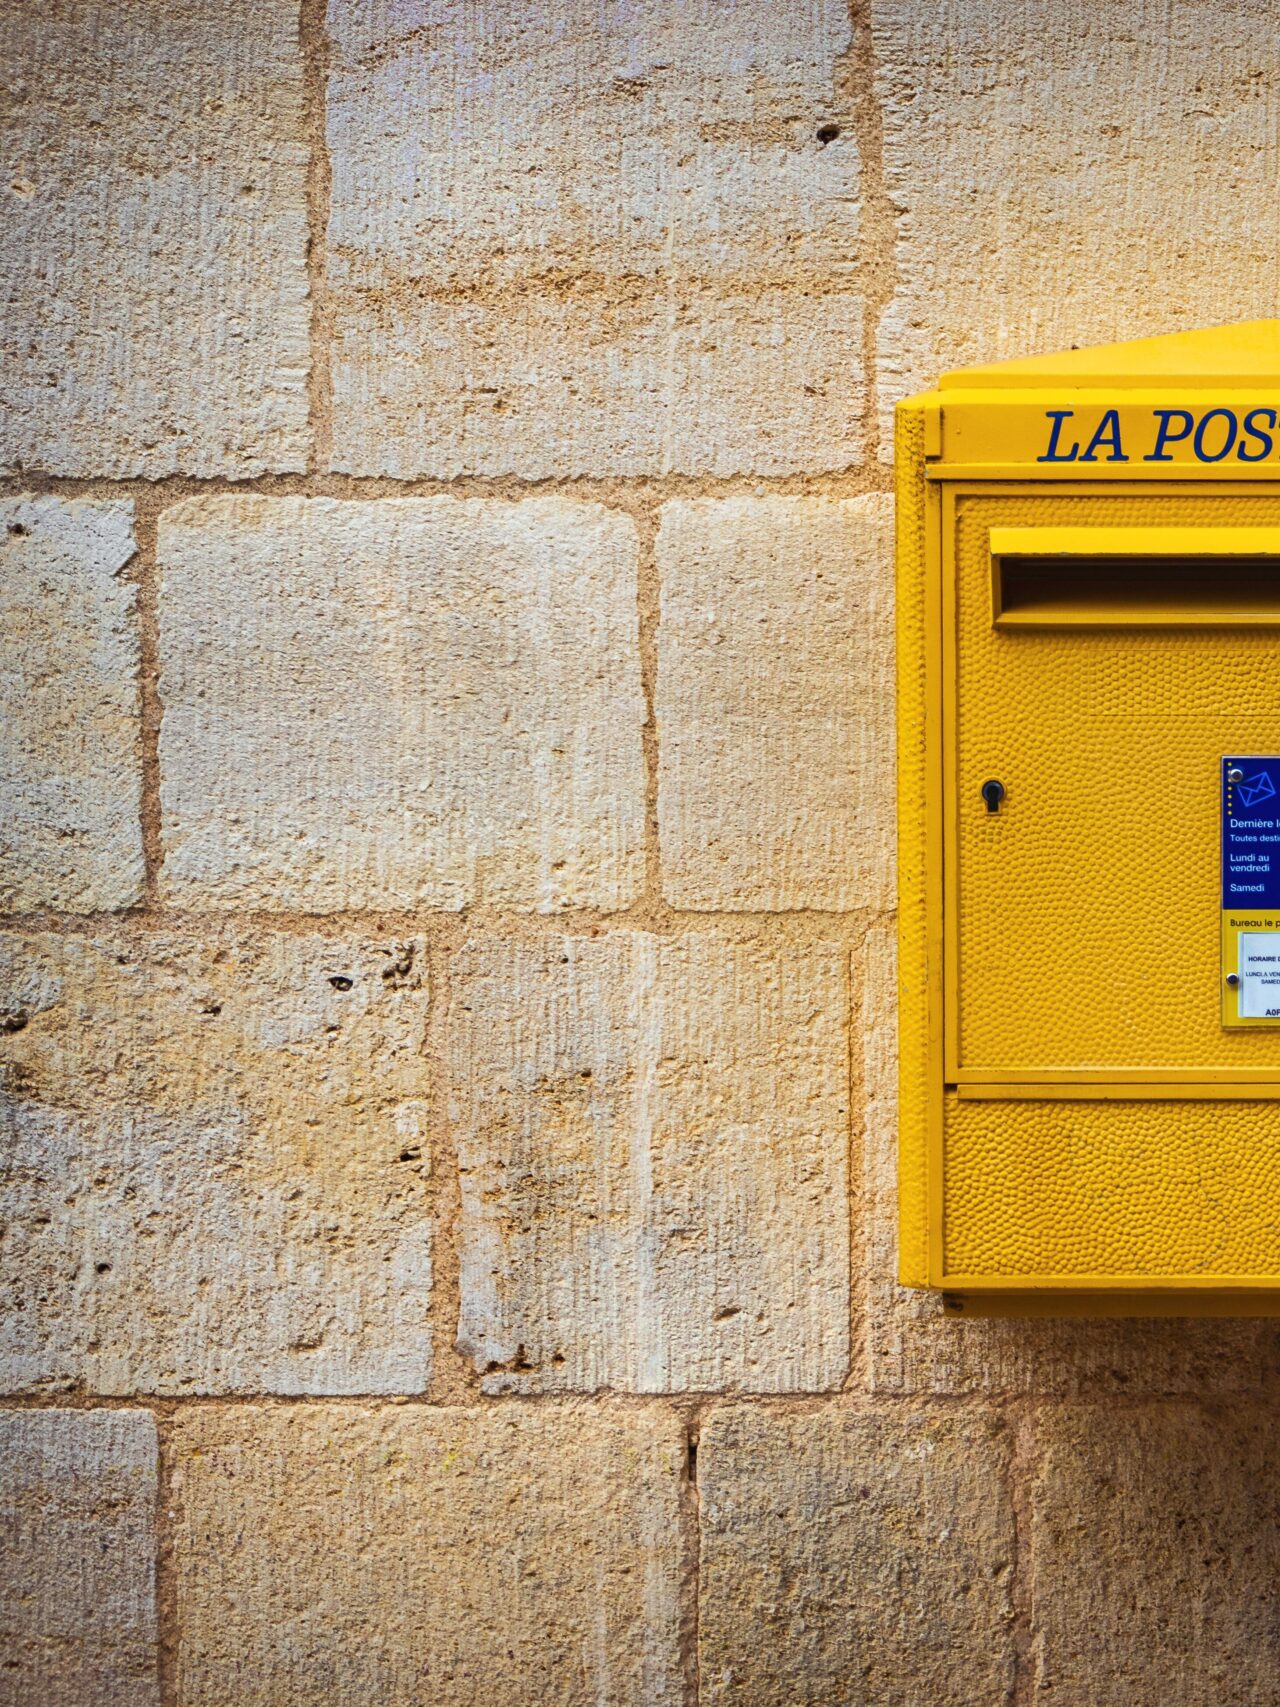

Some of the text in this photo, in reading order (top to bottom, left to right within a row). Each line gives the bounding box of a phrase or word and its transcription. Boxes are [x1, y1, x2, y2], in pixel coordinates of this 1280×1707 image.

[1036, 409, 1129, 463] LA
[1230, 818, 1273, 828] Dernière
[1230, 834, 1257, 842] Toutes
[1230, 853, 1256, 862] Lundi
[1230, 864, 1270, 872] vendredi
[1230, 883, 1265, 892] Samedi
[1230, 919, 1262, 927] Bureau
[1264, 919, 1273, 927] le
